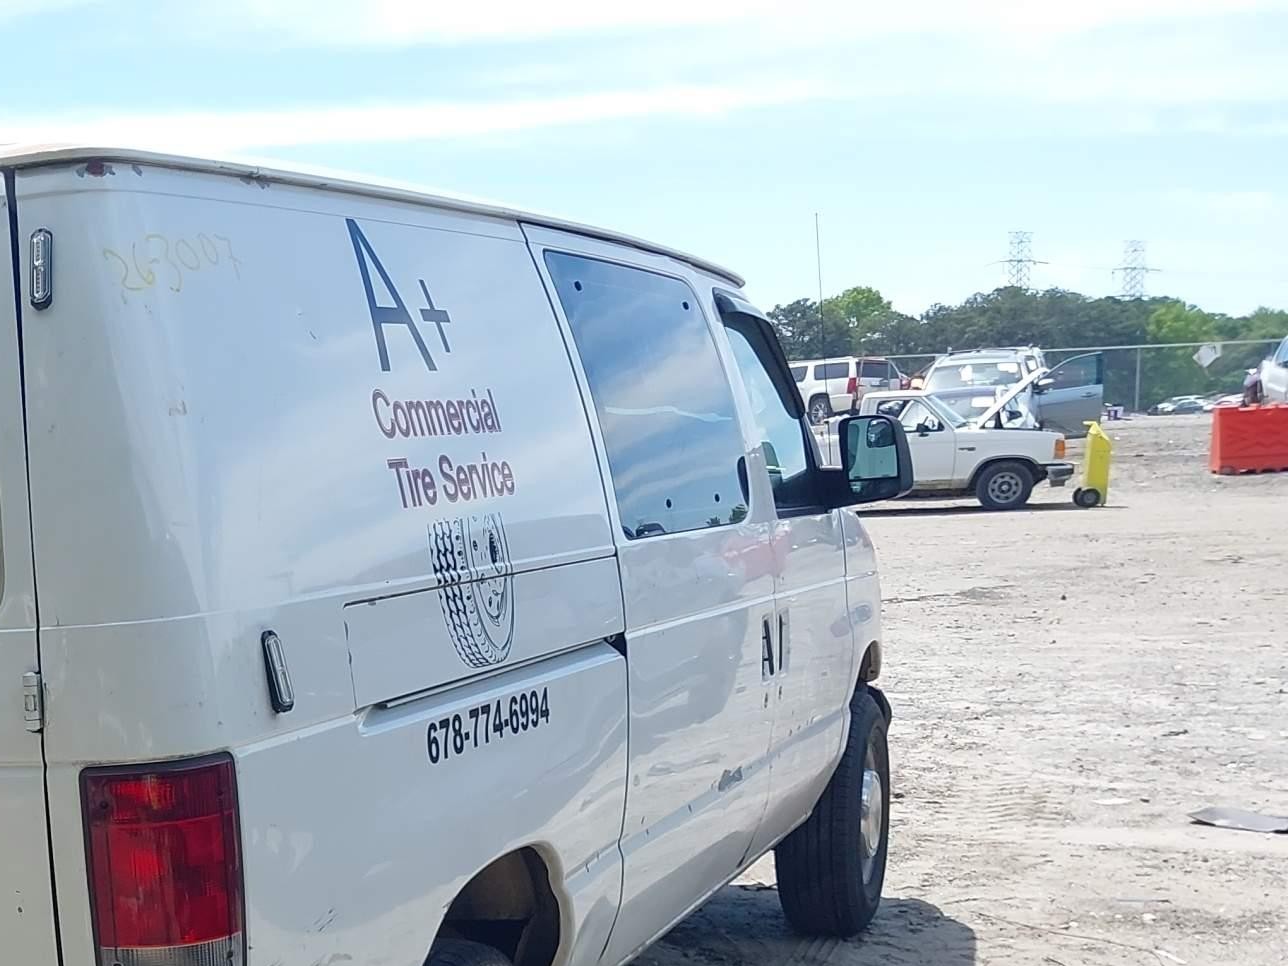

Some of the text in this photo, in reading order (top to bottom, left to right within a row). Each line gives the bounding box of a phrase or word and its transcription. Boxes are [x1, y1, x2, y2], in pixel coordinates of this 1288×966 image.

[345, 218, 451, 372] A+
[372, 388, 502, 440] Commercial
[387, 452, 515, 509] Tire Service
[427, 686, 550, 765] 678-774-6994
